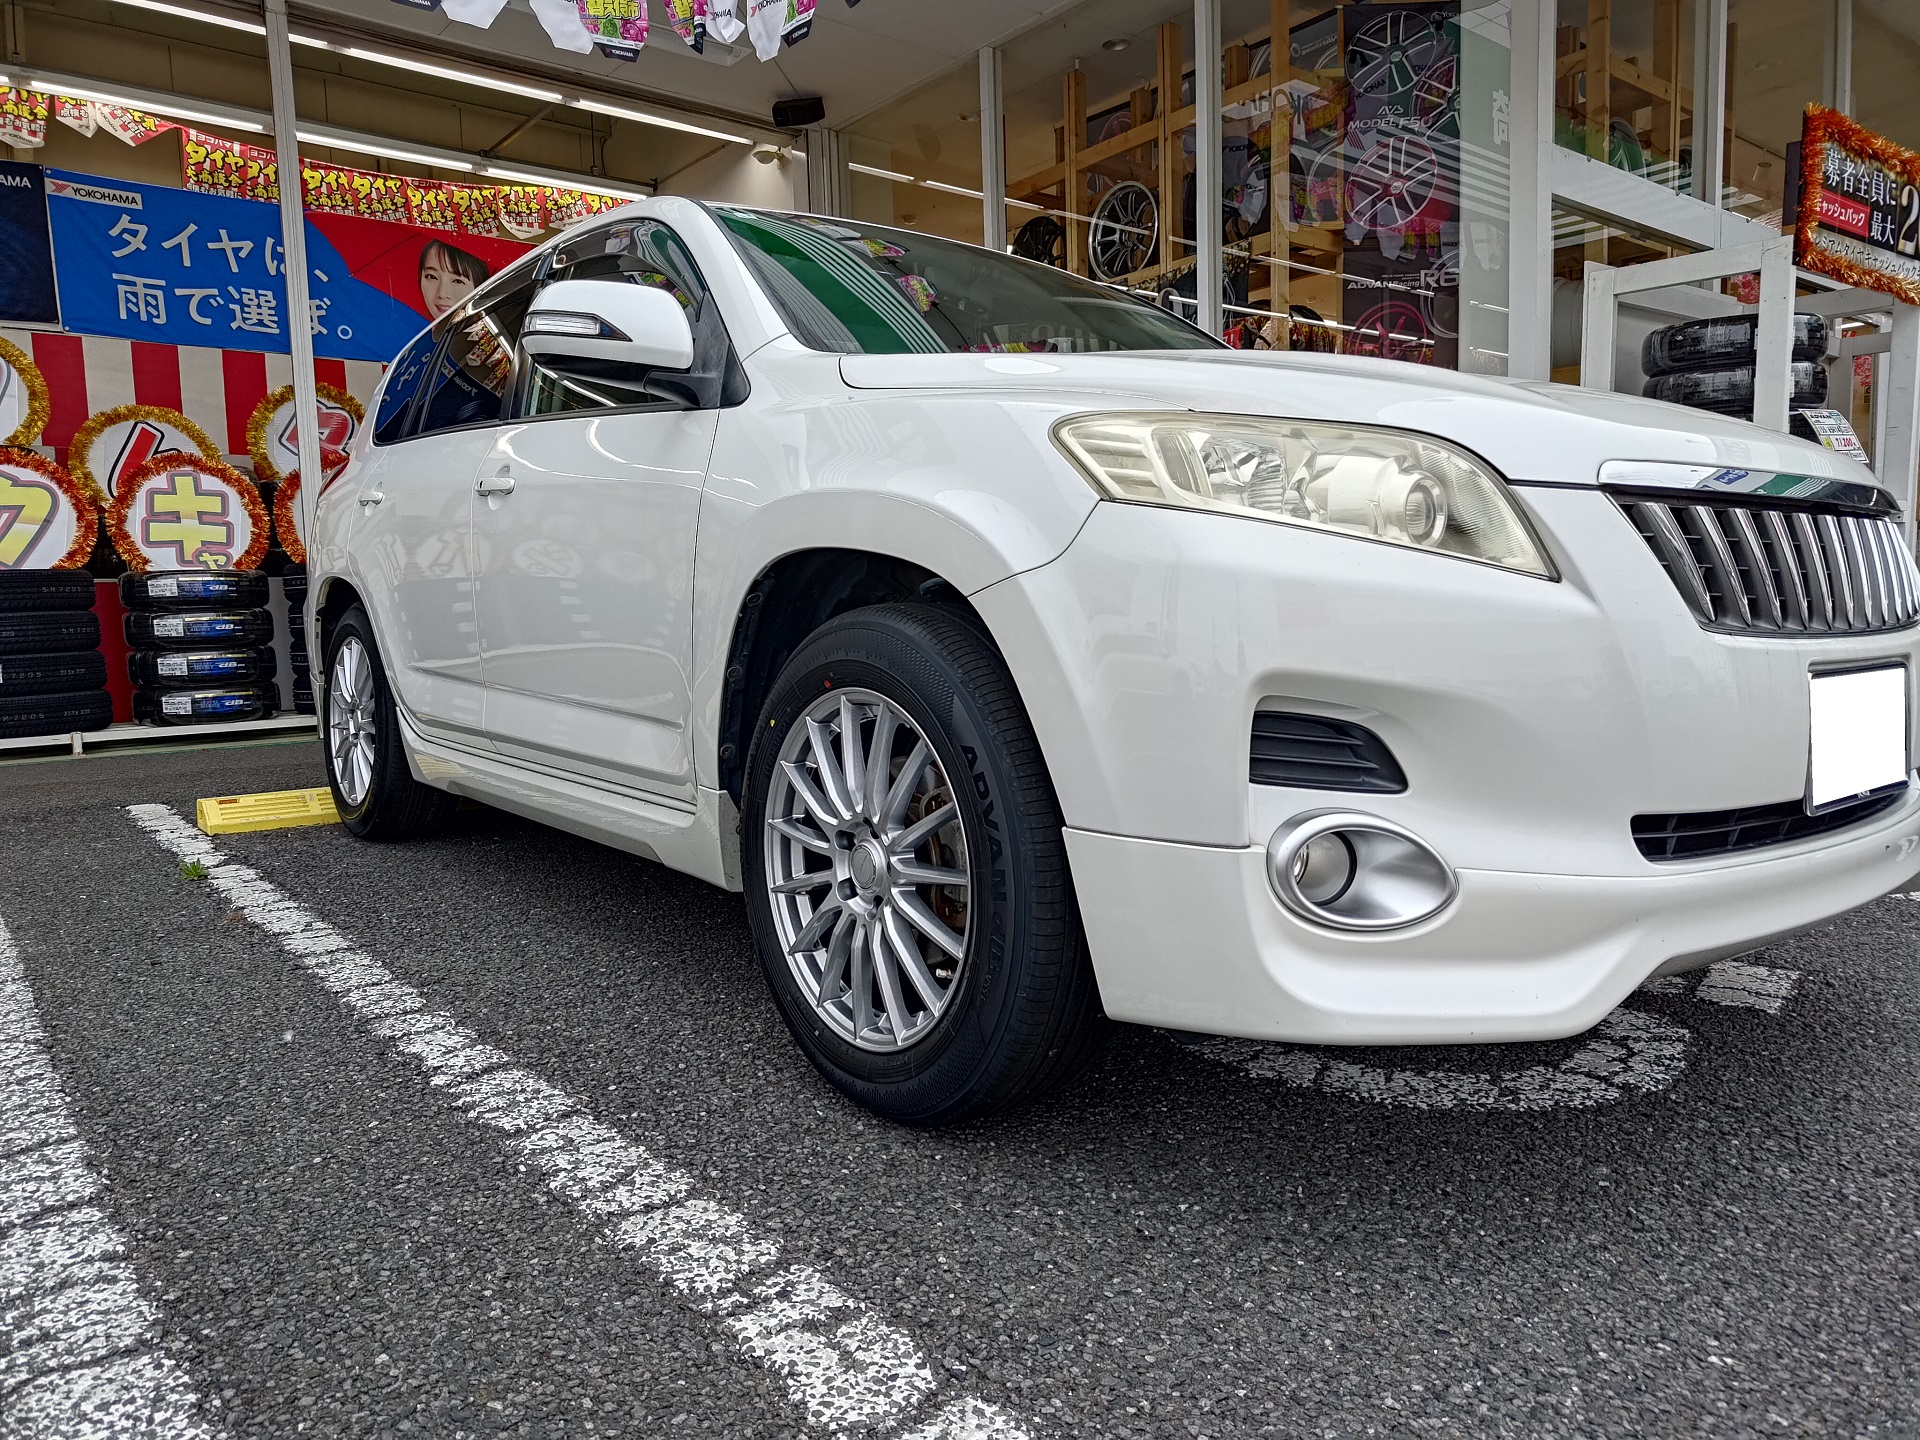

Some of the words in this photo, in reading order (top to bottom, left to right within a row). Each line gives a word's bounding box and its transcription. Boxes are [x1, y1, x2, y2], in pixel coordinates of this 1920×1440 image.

[1348, 117, 1397, 130] MODEL
[185, 141, 246, 172] タイヤ
[70, 186, 139, 206] YOKOHAMA
[351, 174, 402, 199] タイヤ
[1870, 210, 1896, 245] 最大
[1897, 184, 1920, 256] 2
[108, 213, 329, 283] タイヤは、
[1347, 280, 1392, 290] ADVAN
[959, 744, 1008, 904] ADVAN
